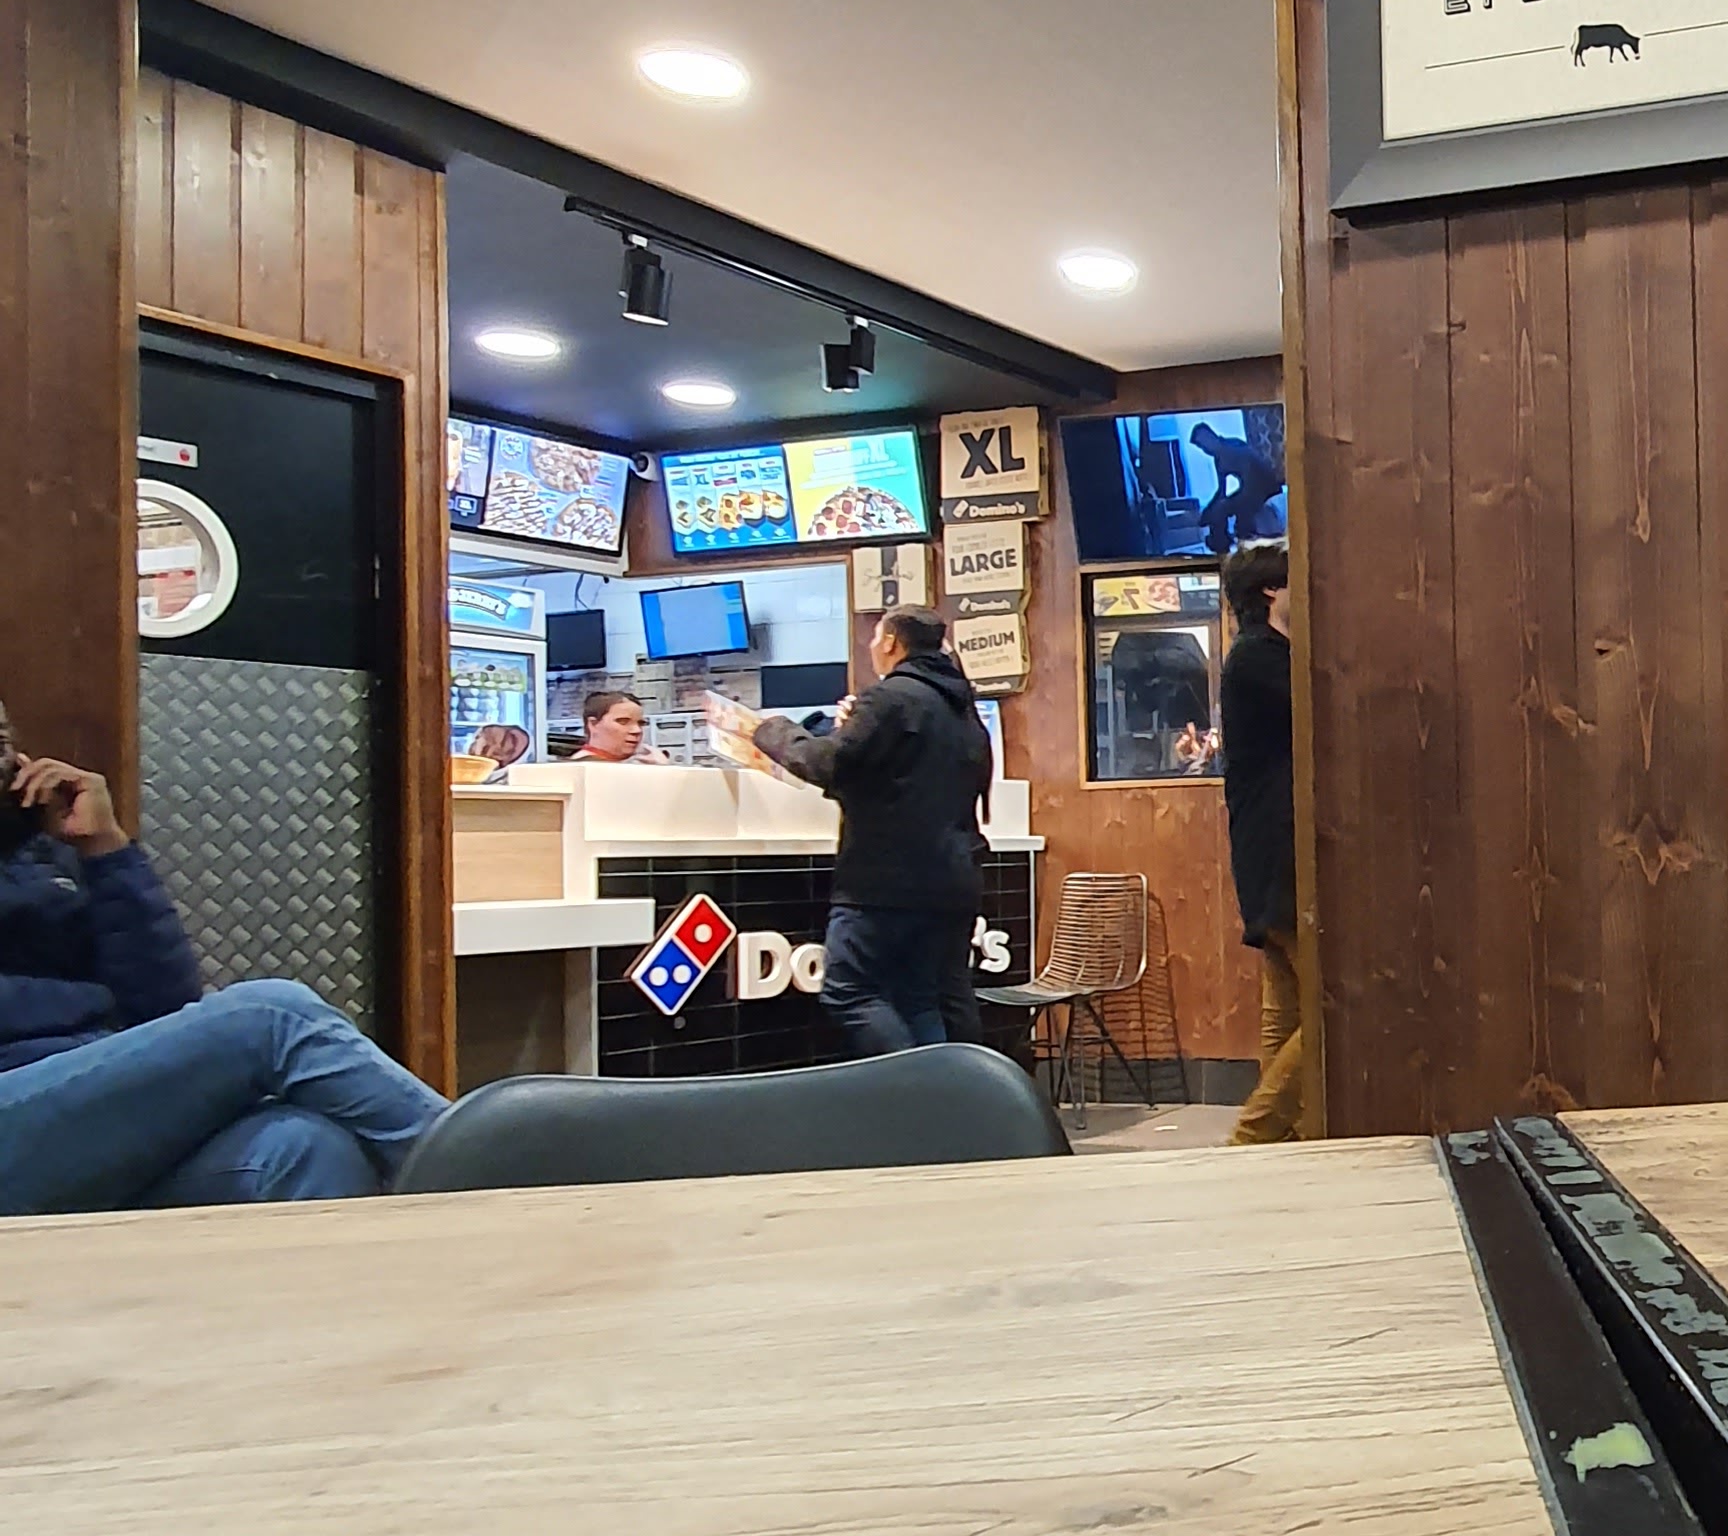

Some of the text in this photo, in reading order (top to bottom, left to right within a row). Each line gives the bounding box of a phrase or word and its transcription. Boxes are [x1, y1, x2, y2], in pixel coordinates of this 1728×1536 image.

[959, 425, 1025, 479] XL
[950, 548, 1017, 577] LARGE
[958, 630, 1015, 654] MEDIUM
